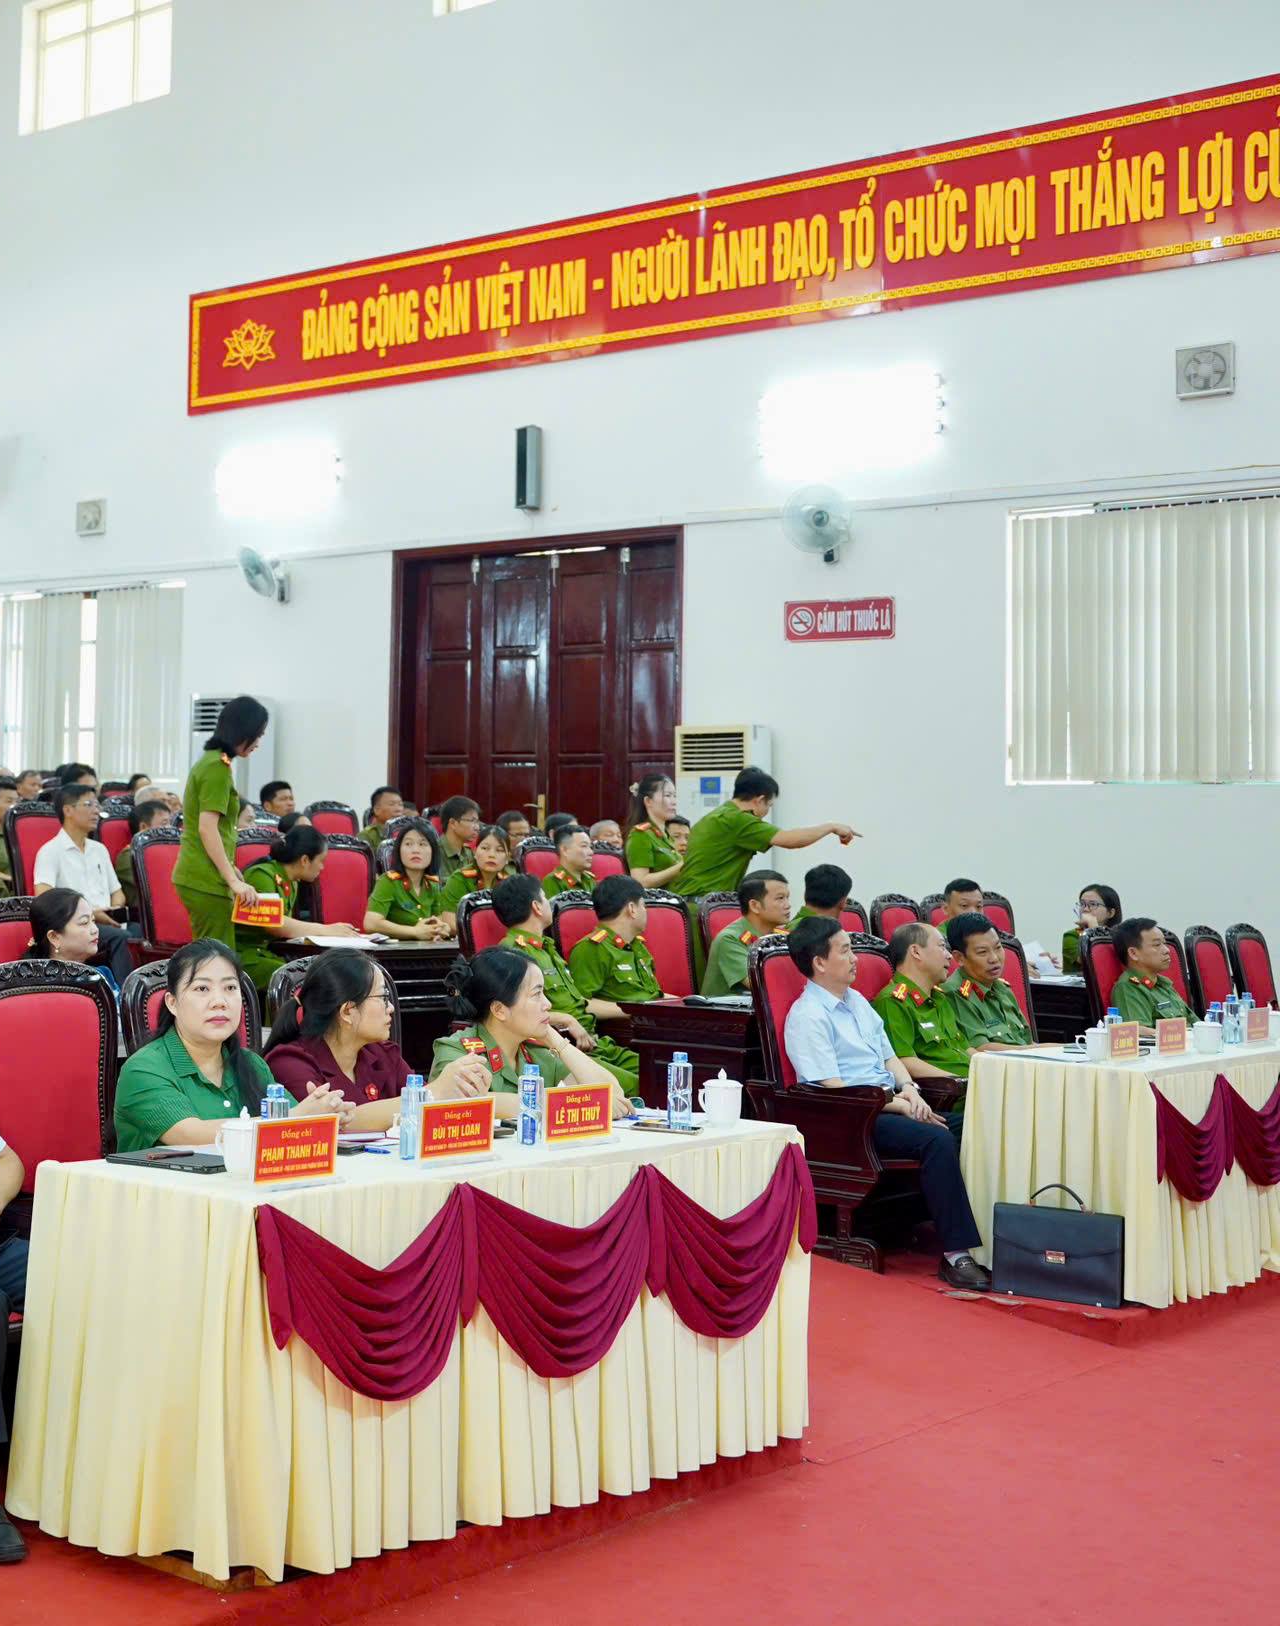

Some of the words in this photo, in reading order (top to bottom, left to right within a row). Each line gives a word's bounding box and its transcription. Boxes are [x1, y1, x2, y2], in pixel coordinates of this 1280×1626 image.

[301, 288, 358, 361] ĐẢNG
[362, 283, 419, 358] CỘNG
[423, 265, 471, 341] SẢN
[476, 261, 525, 338] VIỆT
[528, 258, 587, 323] NAM
[611, 228, 690, 310] NGƯỜI
[695, 220, 767, 296] LÃNH
[772, 214, 837, 292] ĐẠO,
[839, 176, 878, 271] TỔ
[884, 179, 968, 264] CHỨC
[975, 175, 1036, 257] MỌI
[1050, 136, 1166, 236] THẮNG
[1178, 131, 1233, 224] LỢI
[817, 603, 836, 633] CẤM
[836, 605, 852, 633] HÚT
[853, 601, 879, 632] THUỐC
[880, 603, 891, 631] LÁ
[555, 1106, 566, 1125] LÊ
[567, 1108, 580, 1126] THỊ
[432, 1124, 446, 1140] BÙI
[447, 1125, 460, 1140] THỊ
[461, 1123, 481, 1137] LOAN
[261, 1146, 285, 1165] PHẠM
[286, 1144, 311, 1160] THANH
